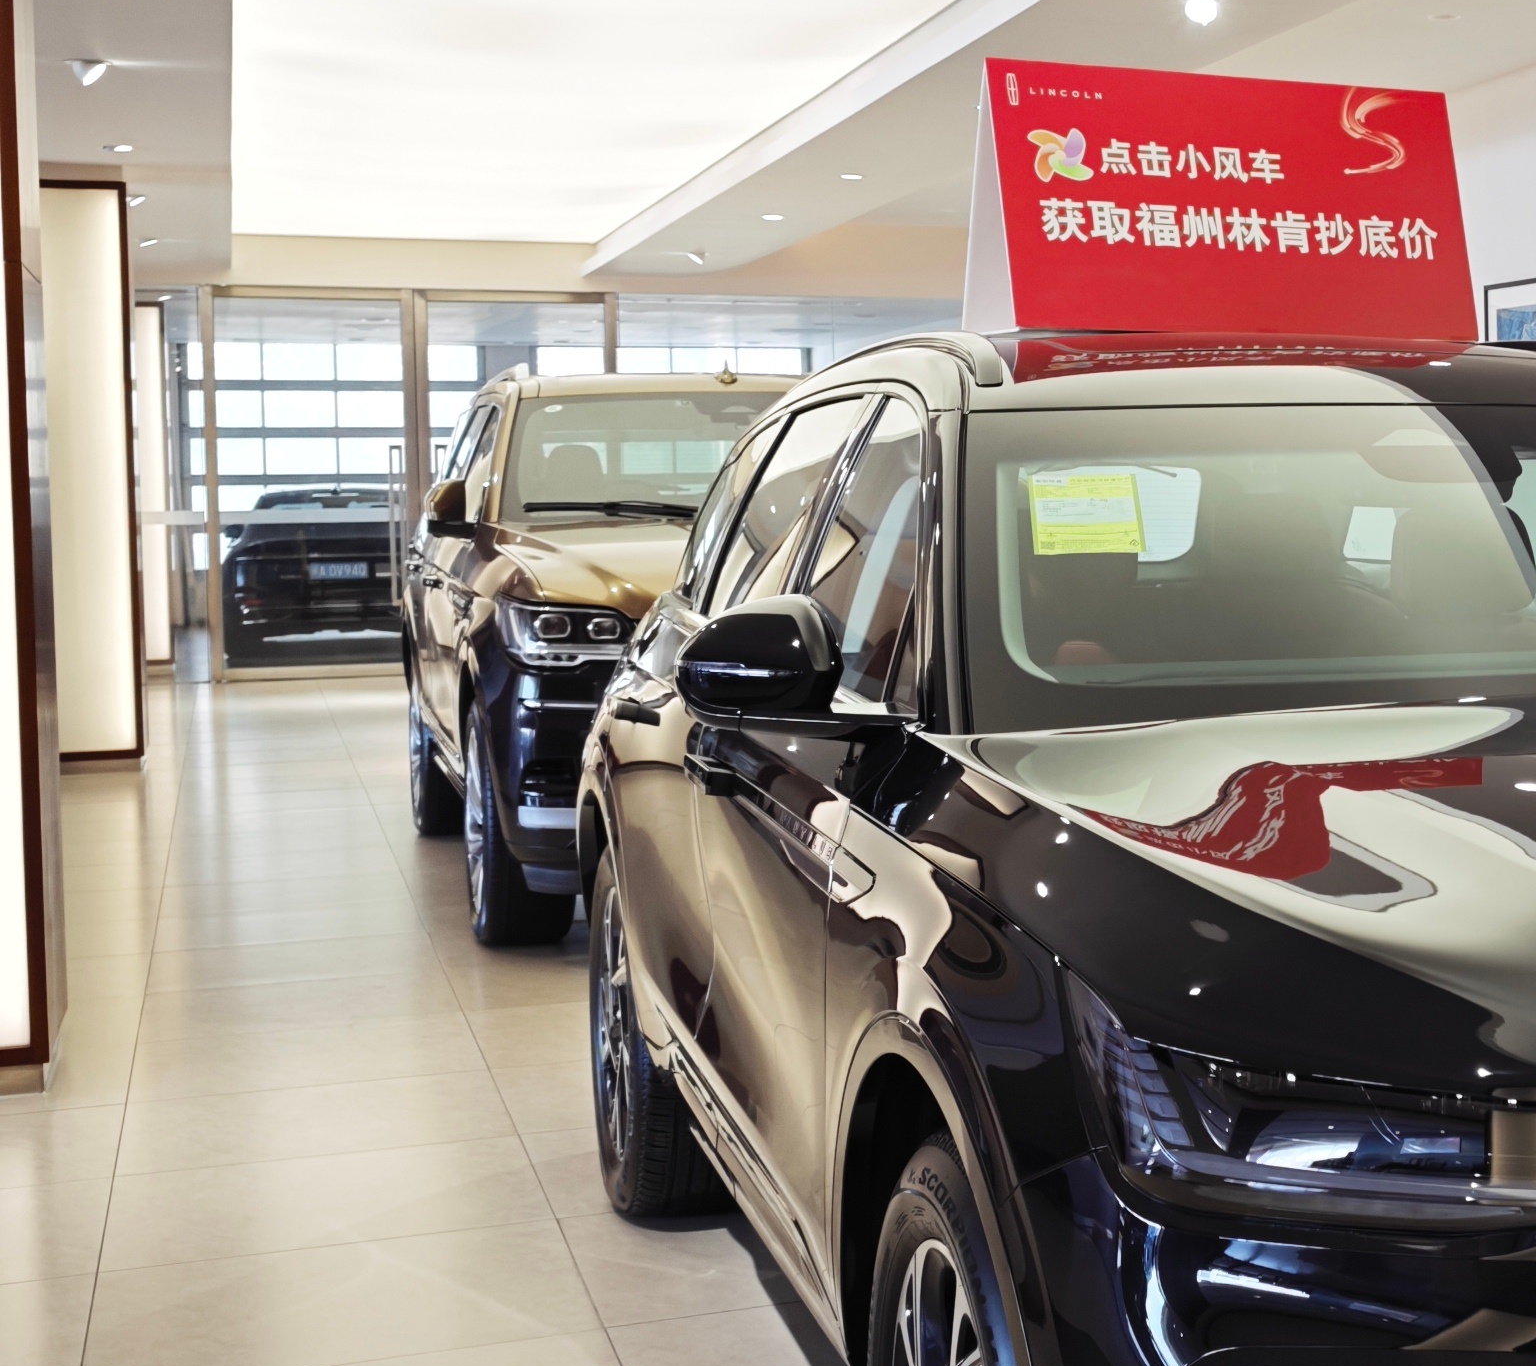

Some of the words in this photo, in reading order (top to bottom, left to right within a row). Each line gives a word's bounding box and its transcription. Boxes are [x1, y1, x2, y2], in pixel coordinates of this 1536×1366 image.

[1029, 87, 1103, 100] LINCOLN
[1100, 138, 1285, 184] 点击小风车
[1039, 197, 1438, 261] 获取福州林肯抄底价
